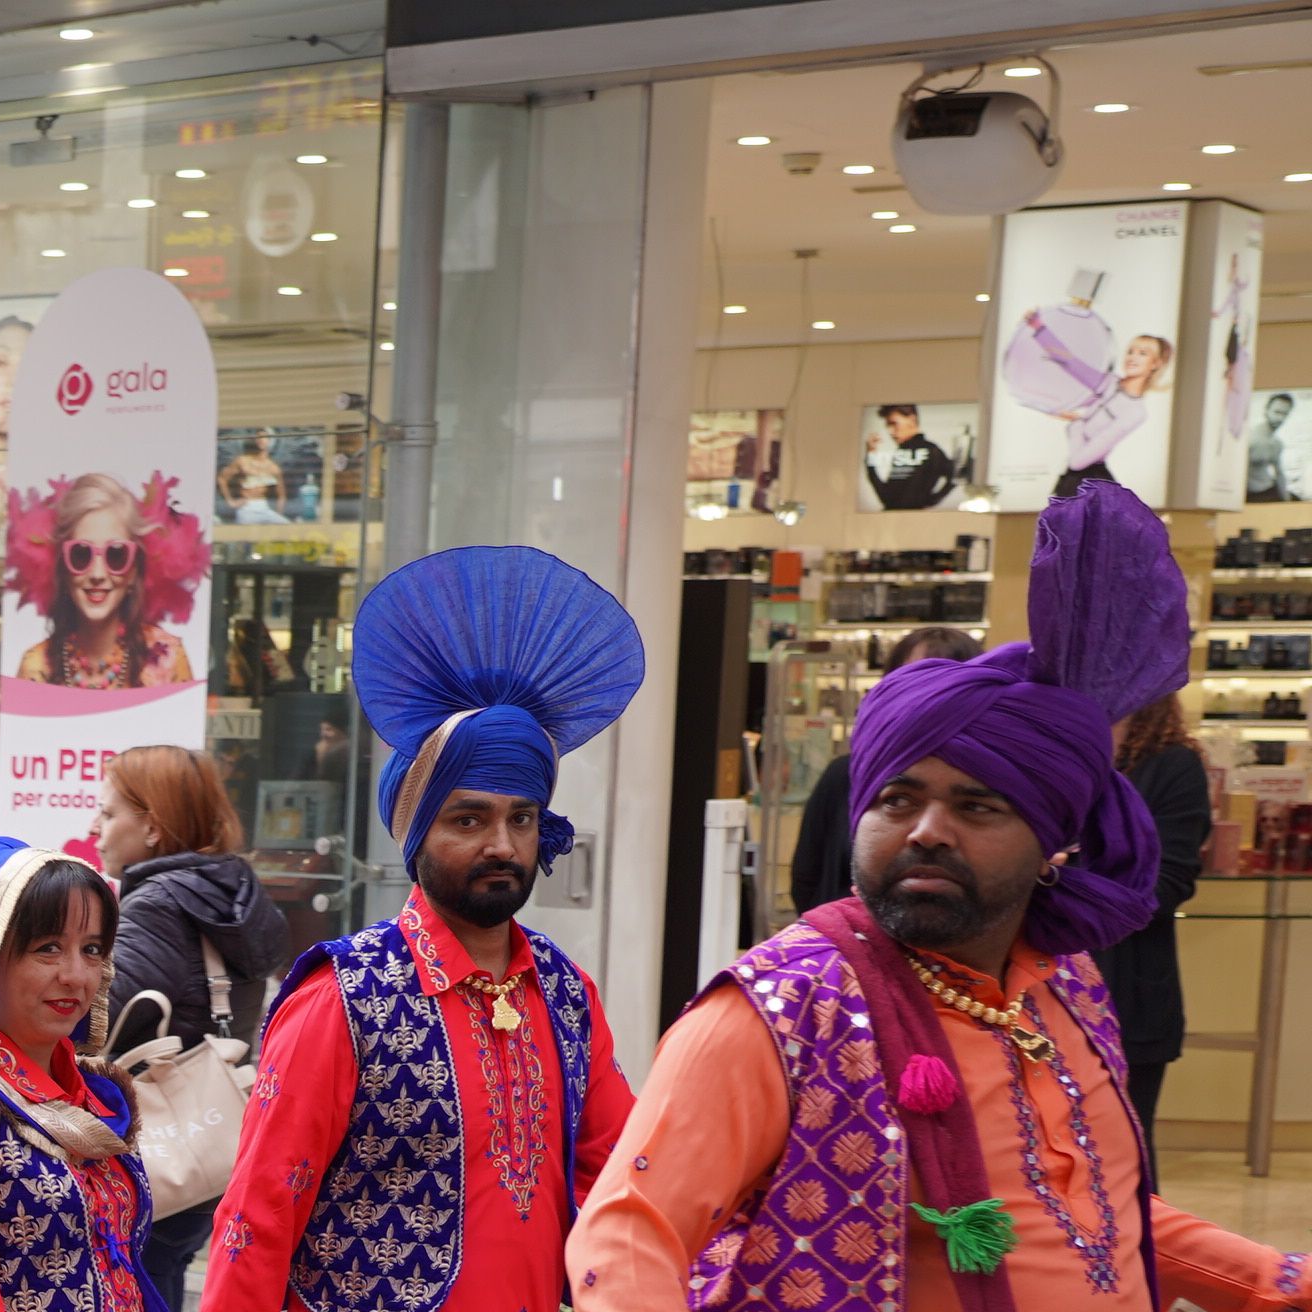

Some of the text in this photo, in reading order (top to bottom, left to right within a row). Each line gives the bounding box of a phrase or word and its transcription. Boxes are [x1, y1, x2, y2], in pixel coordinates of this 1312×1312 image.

[1116, 207, 1180, 222] CHANCE
[1115, 225, 1179, 239] CHANEL
[106, 362, 167, 399] gala
[12, 754, 48, 780] un
[12, 788, 97, 811] per cada
